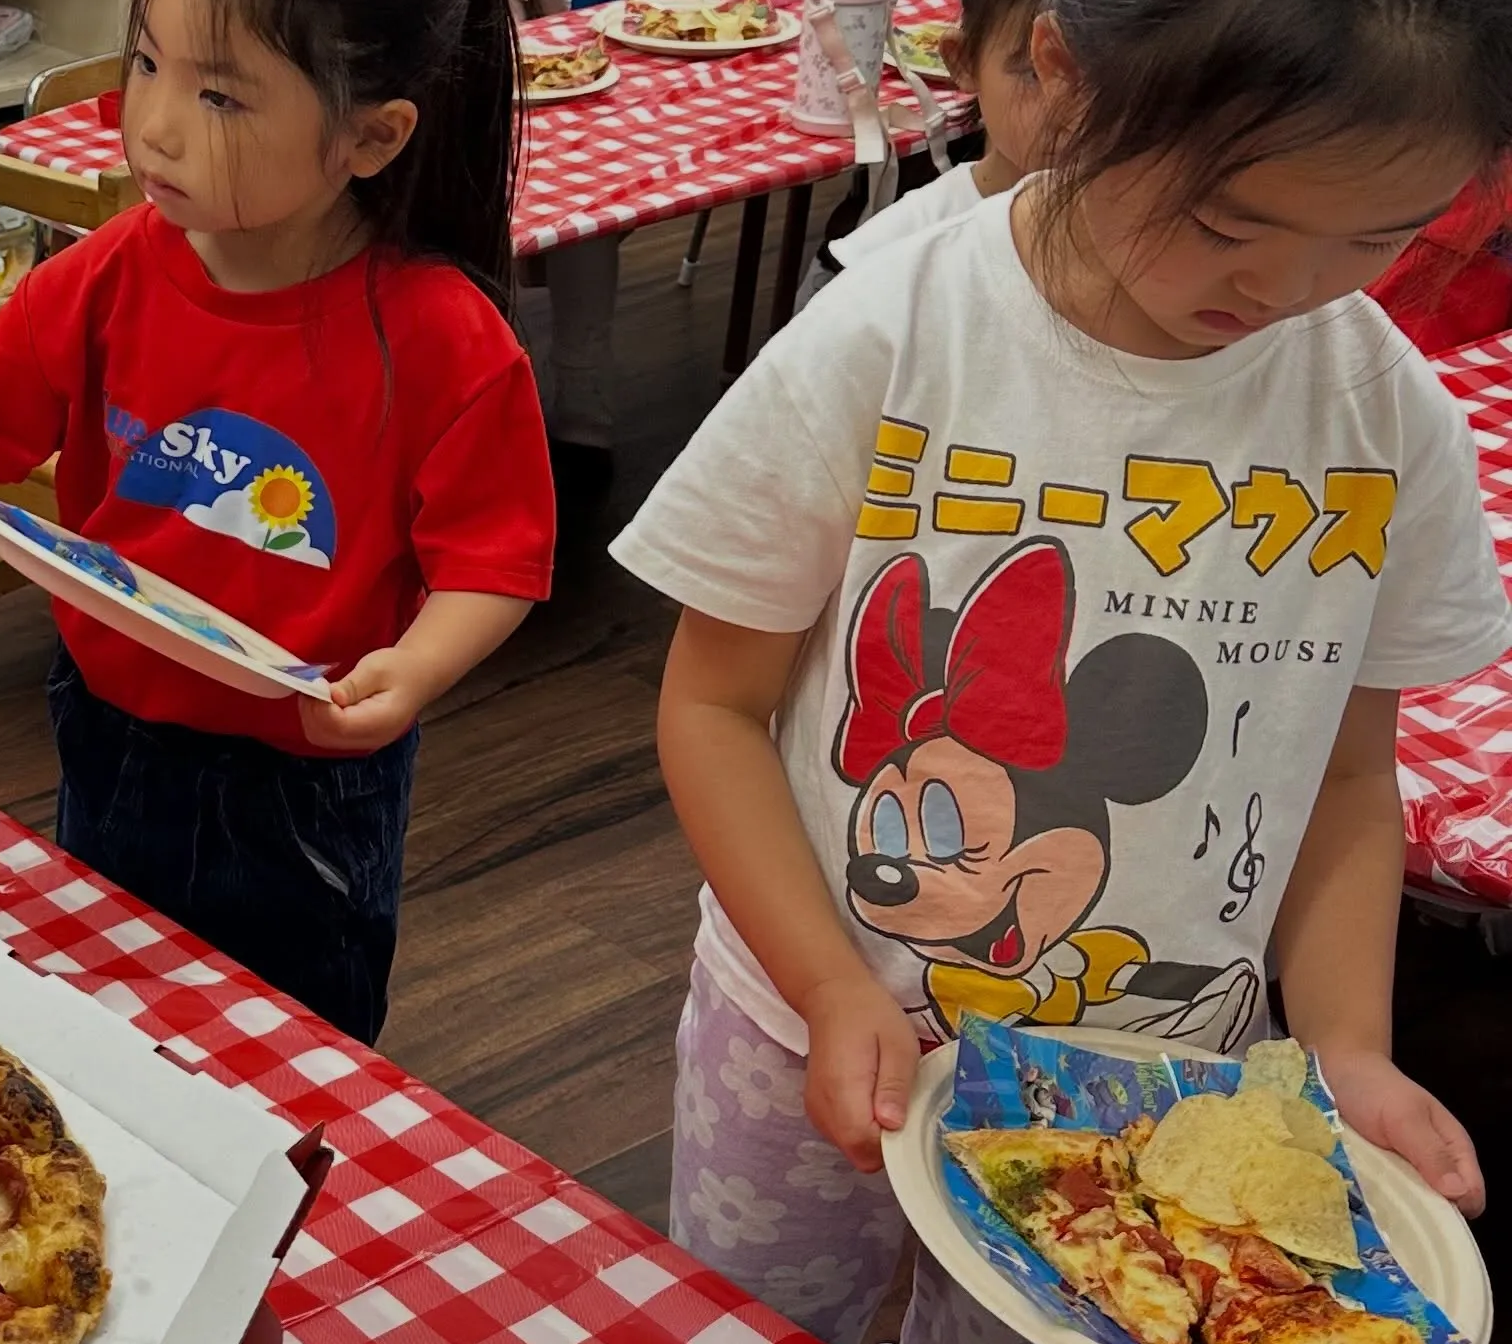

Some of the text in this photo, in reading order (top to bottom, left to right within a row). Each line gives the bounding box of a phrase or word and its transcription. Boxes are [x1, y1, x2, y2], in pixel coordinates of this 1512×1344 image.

[160, 422, 251, 485] Sky
[855, 415, 1399, 579] ミニーマウス
[1105, 590, 1259, 625] MINNIE
[1216, 639, 1344, 666] MOUSE
